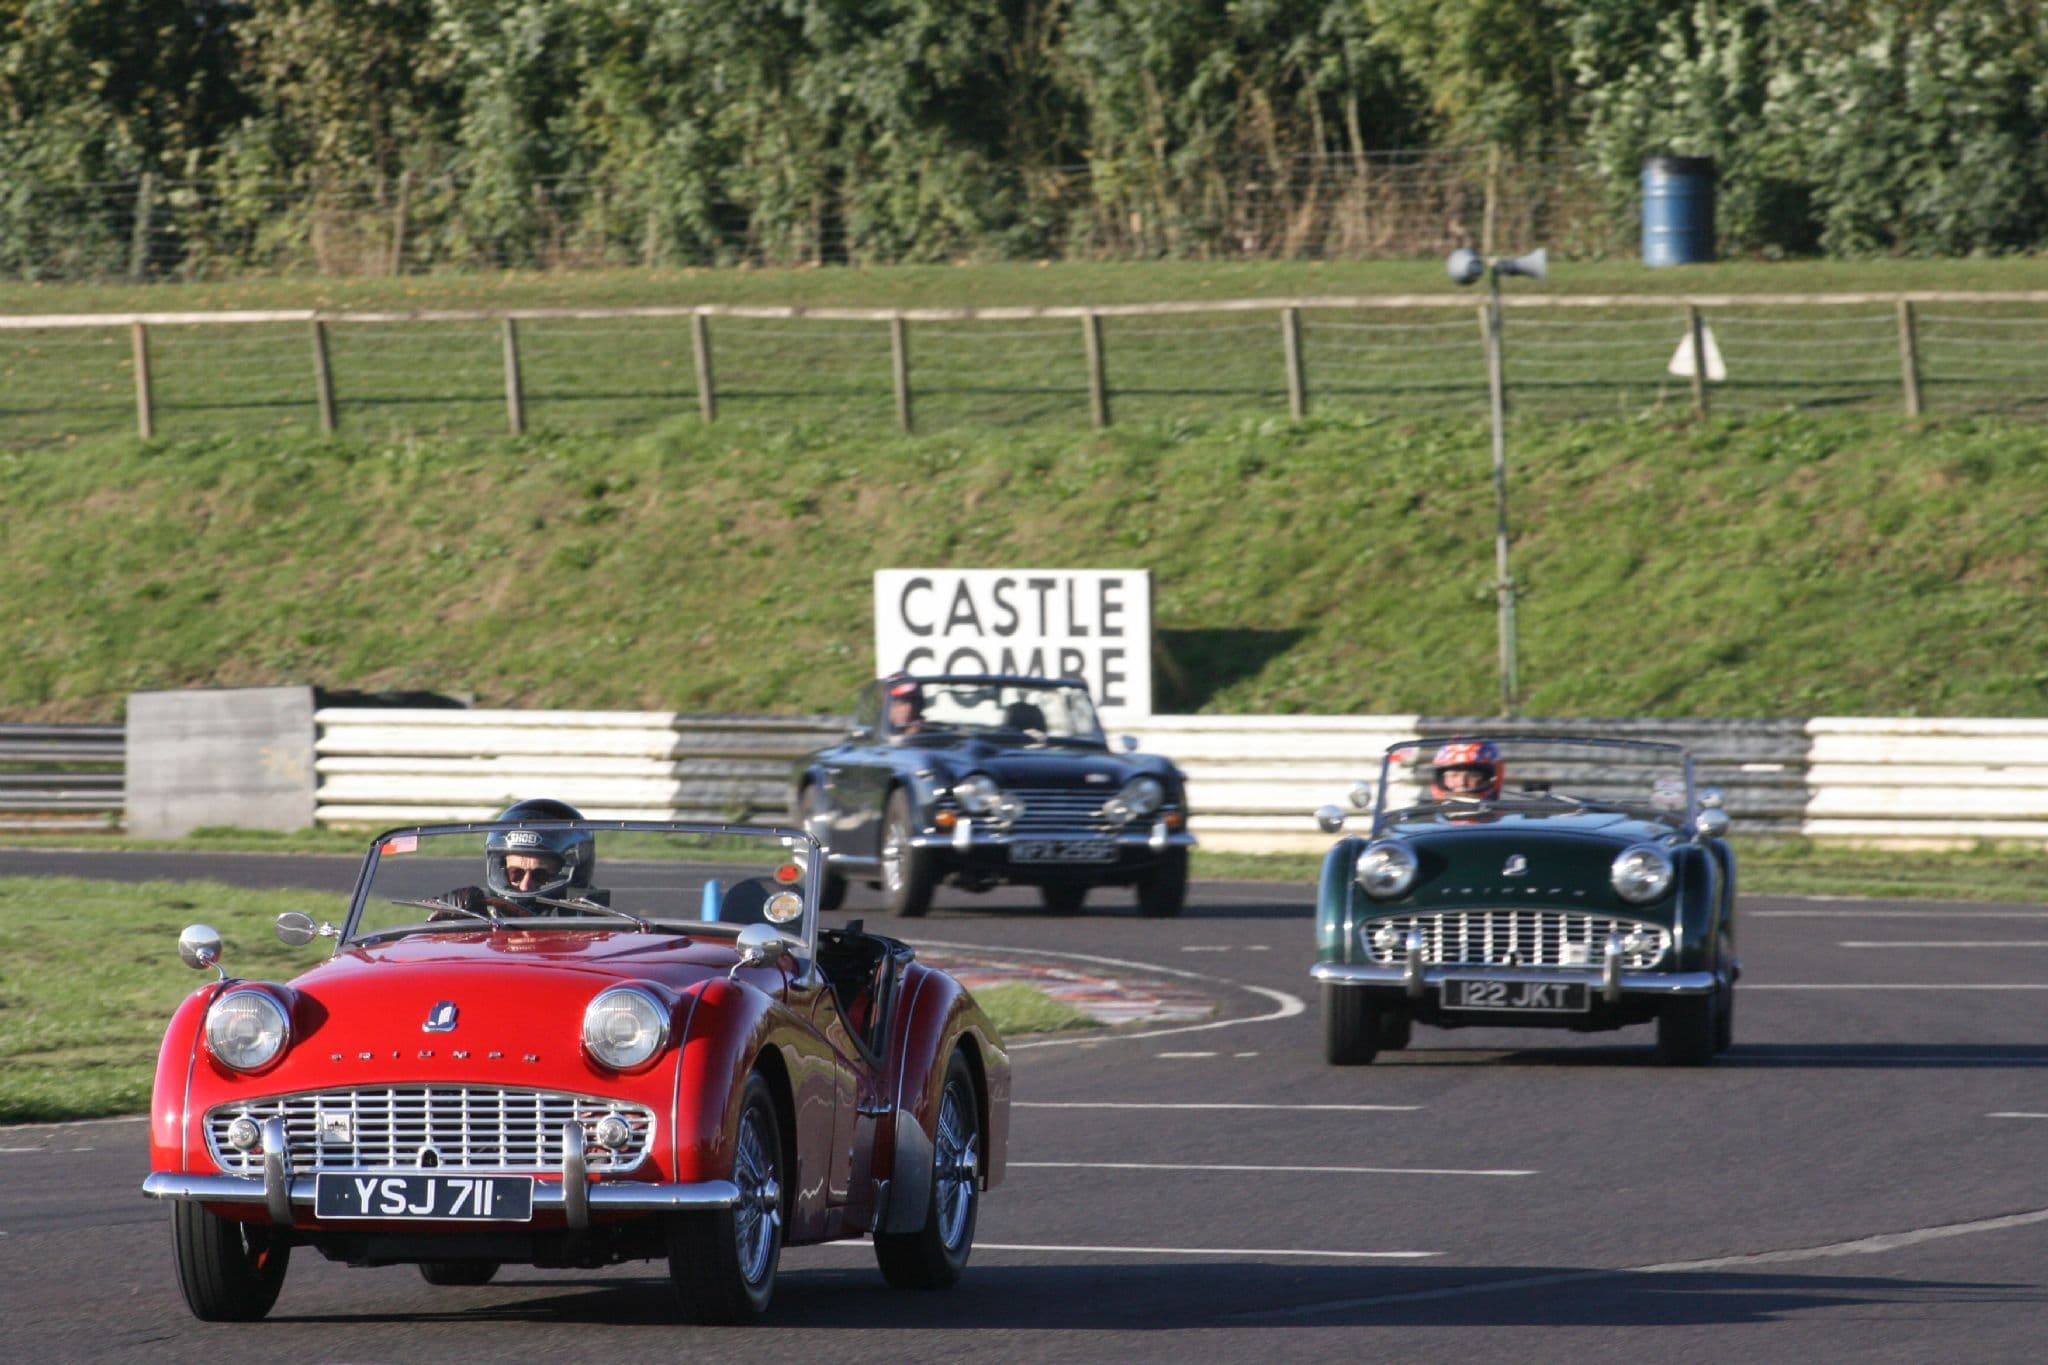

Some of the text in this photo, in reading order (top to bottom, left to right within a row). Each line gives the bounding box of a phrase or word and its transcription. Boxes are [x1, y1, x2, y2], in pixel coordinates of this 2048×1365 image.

[899, 577, 1125, 637] CASTLE
[1460, 982, 1570, 1008] 122 JKT
[354, 1178, 494, 1215] YSJ 711
